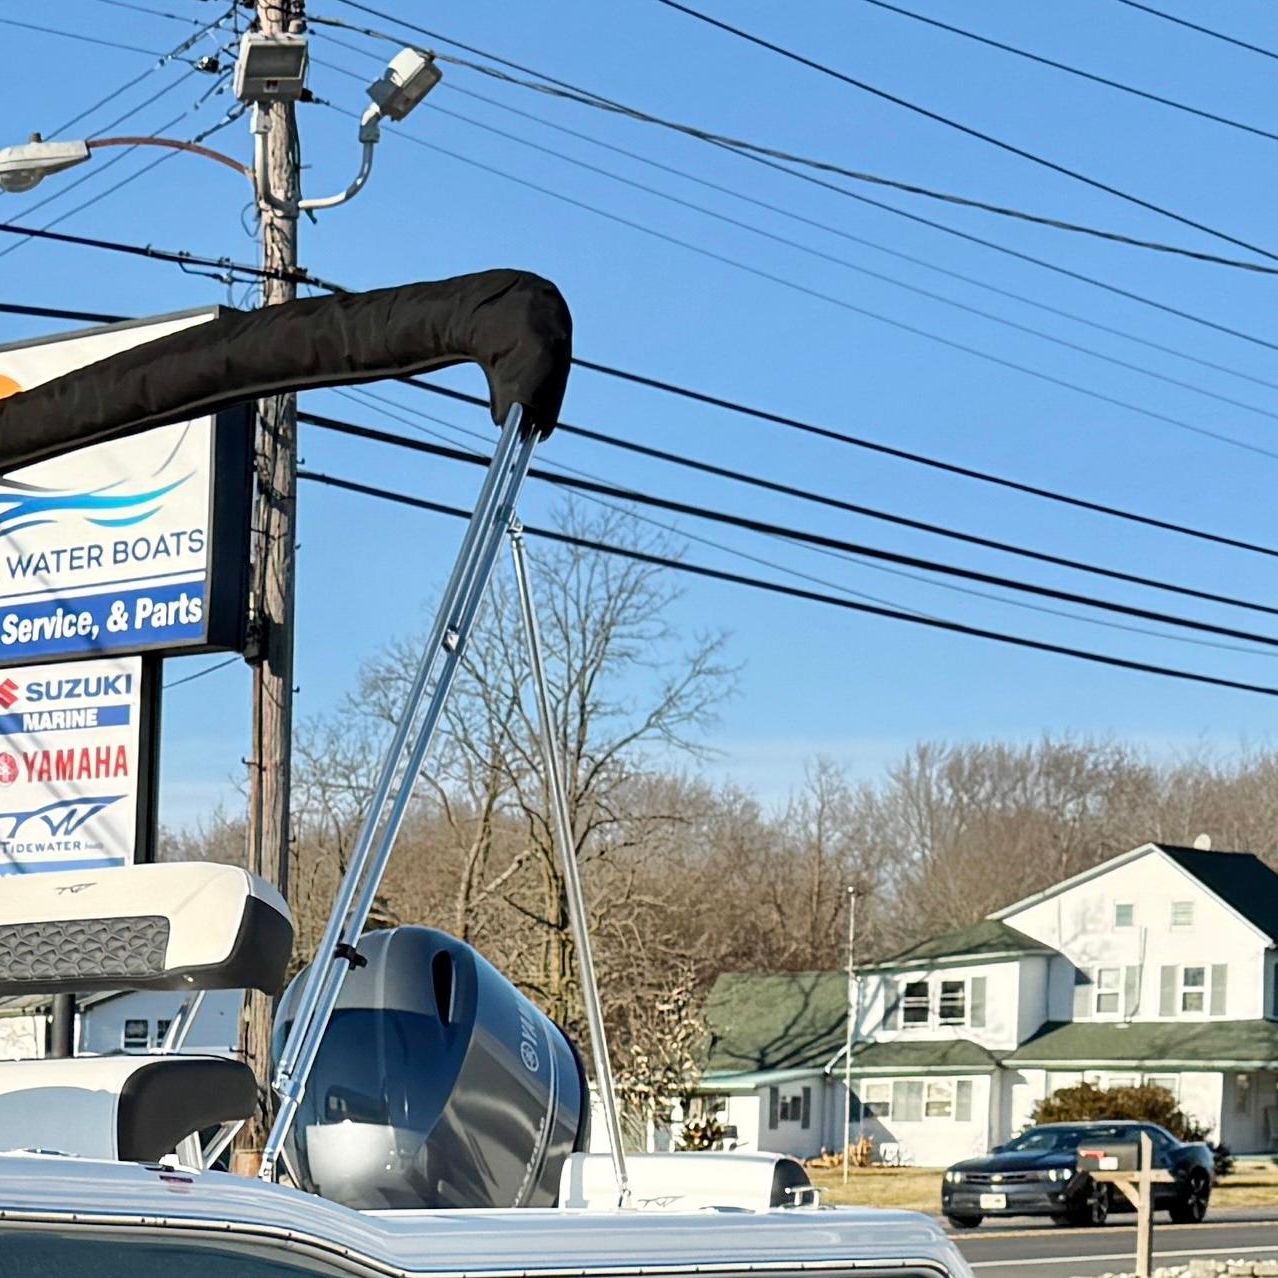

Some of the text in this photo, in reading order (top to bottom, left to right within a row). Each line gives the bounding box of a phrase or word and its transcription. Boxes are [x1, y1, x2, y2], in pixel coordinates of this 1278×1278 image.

[6, 544, 104, 579] WATER
[112, 528, 204, 565] BOATS
[0, 607, 100, 645] Service,
[106, 600, 129, 632] &
[134, 593, 203, 630] Parts
[25, 673, 133, 702] SUZUKI
[22, 707, 99, 733] MARINE
[22, 744, 129, 783] YAMAHA
[0, 840, 81, 854] TIDEWATER
